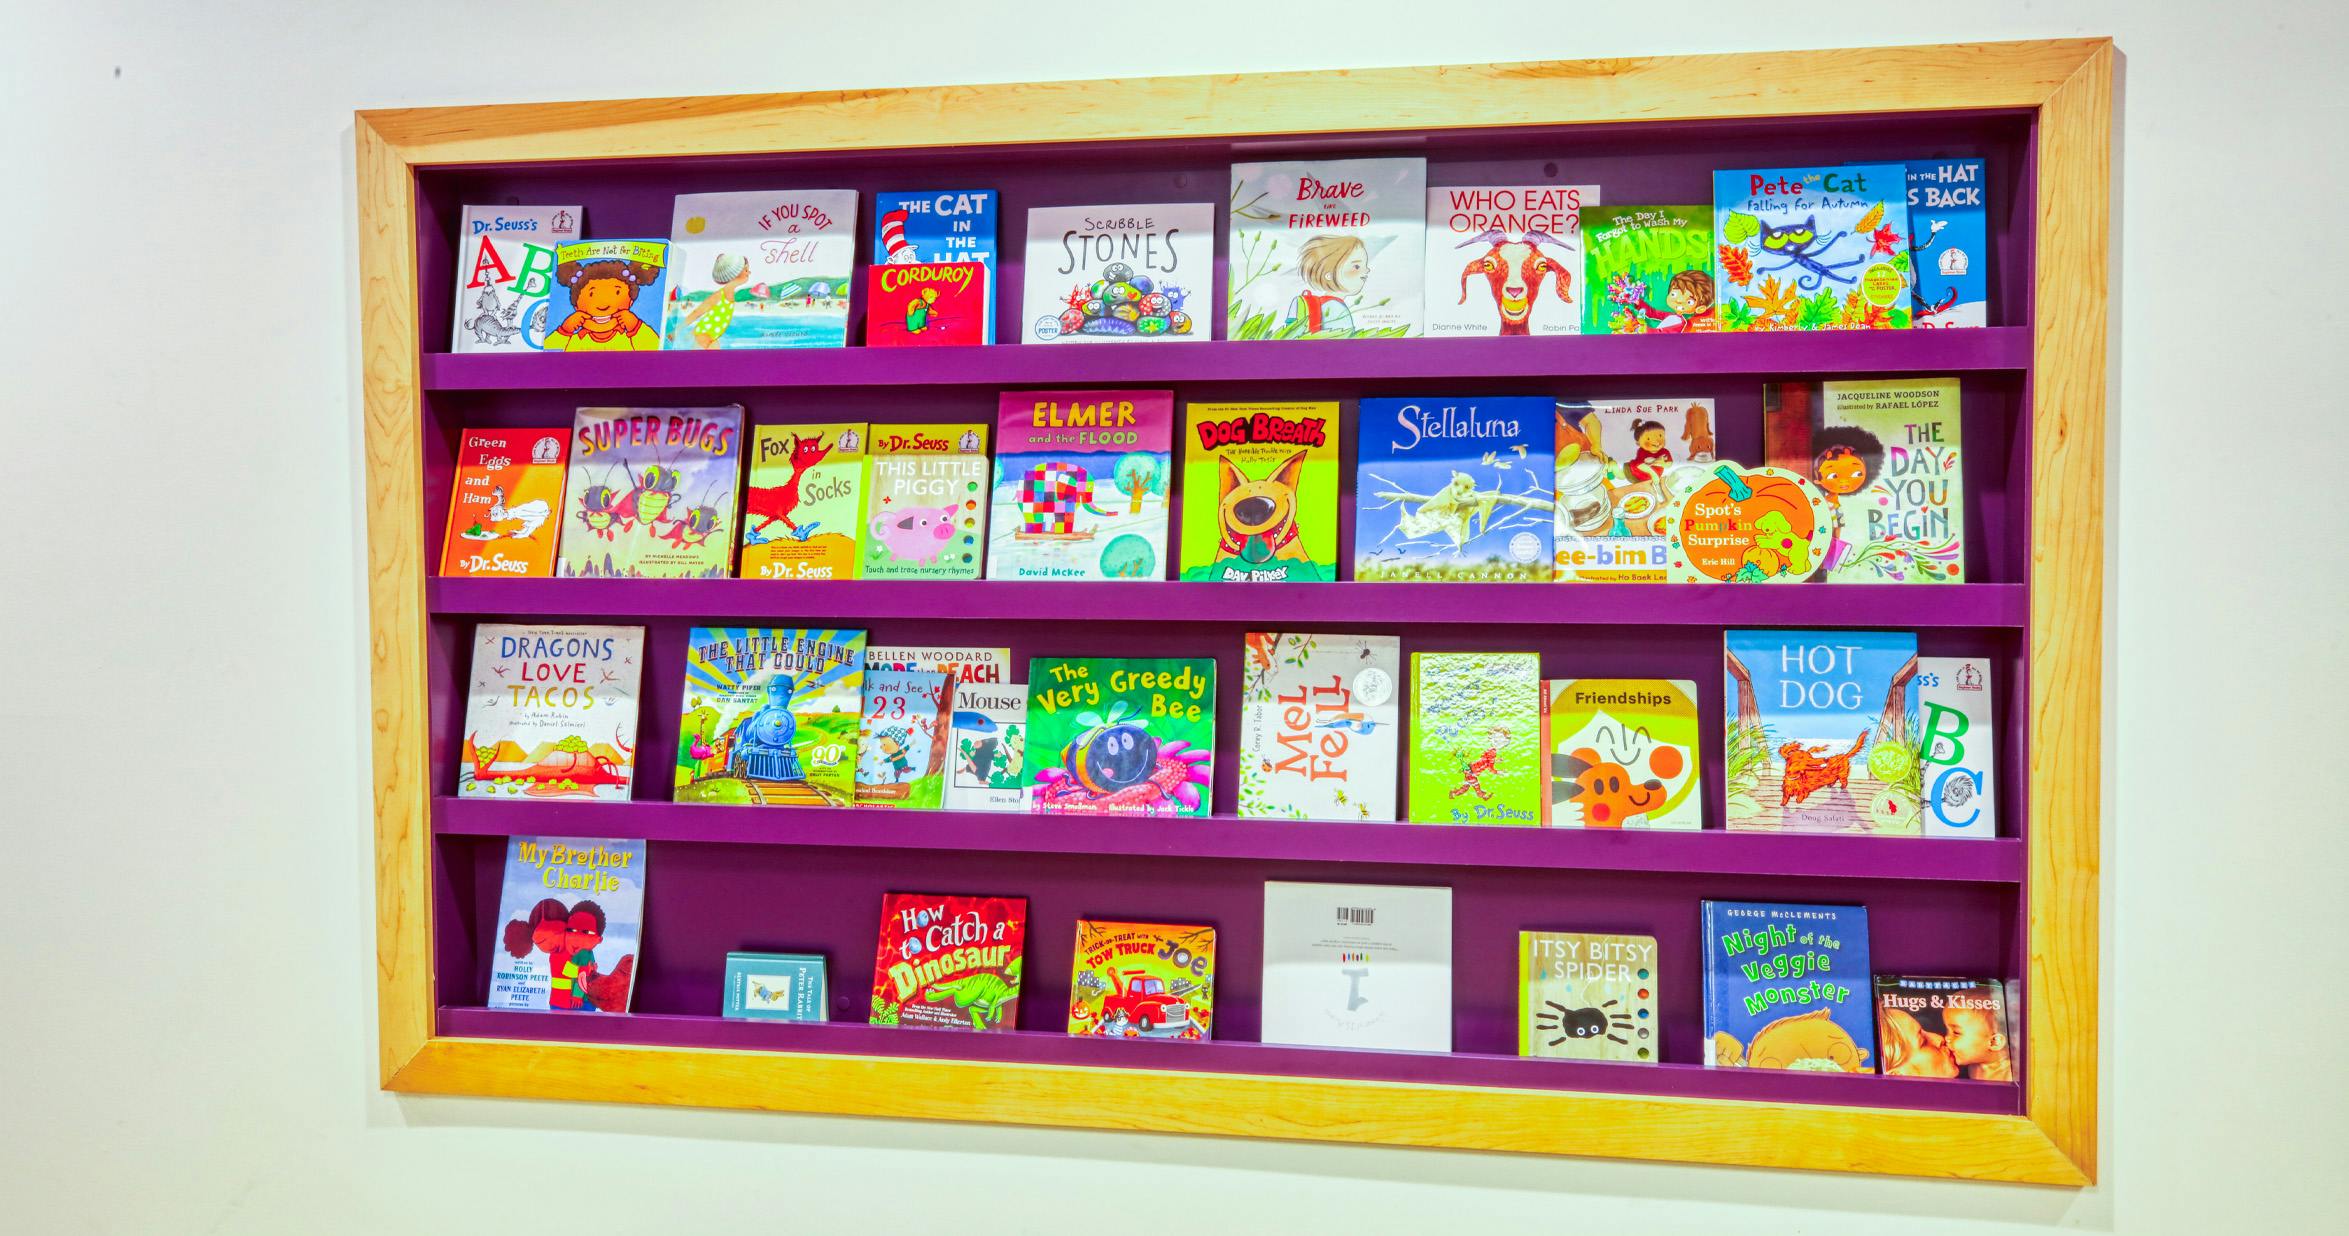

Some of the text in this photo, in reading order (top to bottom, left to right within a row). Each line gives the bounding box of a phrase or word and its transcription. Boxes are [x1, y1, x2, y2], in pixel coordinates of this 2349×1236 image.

[1920, 173, 1936, 181] THE
[1938, 164, 1978, 183] HAT
[1297, 177, 1364, 200] Brave
[1750, 173, 1868, 196] Pete the Cat
[899, 194, 988, 216] THE CAT
[1450, 190, 1580, 211] WHO EATS
[1748, 197, 1868, 214] Falling for Autumn
[1925, 187, 1981, 208] BACK
[472, 217, 538, 234] Dr. Seuss's
[758, 204, 832, 231] IF YOU SPOT
[954, 221, 971, 232] IN
[1085, 218, 1154, 231] SCRIBBLE
[1450, 214, 1579, 234] ORANGE?
[1613, 216, 1633, 226] The
[1636, 212, 1657, 220] Day
[788, 224, 800, 234] a
[1596, 226, 1628, 242] Forgot
[1631, 223, 1641, 231] to
[1674, 218, 1688, 227] My
[946, 237, 976, 248] THE
[1058, 229, 1180, 275] STONES
[1590, 228, 1709, 273] HANDS
[561, 245, 659, 262] Teeth Are Not for Biting
[881, 266, 974, 297] CORDUROY
[1432, 323, 1462, 331] Dianne
[1837, 391, 1940, 401] JACQUELINE WOODSON
[1032, 401, 1136, 428] ELMER
[1605, 405, 1632, 414] LINDA
[1657, 405, 1679, 413] PARK
[579, 415, 734, 457] SUPER BUGS
[1029, 432, 1138, 445] and the FLOOD
[1197, 417, 1248, 450] DOG
[1392, 405, 1522, 454] Stellaluna
[1904, 422, 1945, 445] THE
[469, 437, 507, 448] Green
[761, 437, 790, 462] Fox
[879, 433, 949, 452] By Dr. Seuss
[480, 454, 511, 470] Eggs
[877, 461, 981, 476] THIS LITTLE
[1890, 446, 1945, 477] DAY
[465, 476, 491, 486] and
[812, 470, 821, 480] in
[803, 477, 852, 507] Socks
[894, 479, 959, 496] PIGGY
[1884, 479, 1949, 510] YOU
[463, 493, 491, 504] Ham
[1695, 503, 1742, 518] Spot's
[1685, 519, 1753, 533] Pumpkin
[1688, 535, 1750, 548] Surprise
[460, 553, 528, 573] By Dr. Seuss
[761, 561, 833, 579] By Dr. Seuss
[866, 566, 884, 574] Touch
[948, 567, 974, 575] rhymes
[1702, 558, 1718, 566] Eric
[1019, 568, 1085, 577] David McKee
[501, 637, 615, 661] DRAGONS
[698, 637, 855, 667] THE LITTLE ENGINE
[869, 651, 993, 662] BELLEN WOODARD
[726, 653, 825, 674] THAT COULD
[1782, 645, 1863, 675] HOT
[522, 662, 586, 683] LOVE
[1050, 663, 1089, 683] The
[1110, 666, 1206, 699] Greedy
[879, 681, 923, 693] and See
[1779, 680, 1863, 710] DOG
[507, 685, 595, 710] TACOS
[958, 692, 1021, 710] Mouse
[1036, 681, 1100, 715] Very
[1576, 693, 1671, 707] Friendships
[1151, 693, 1201, 723] Bee
[1157, 804, 1172, 812] Jack
[1175, 805, 1194, 813] Tickle
[1452, 804, 1534, 823] By Dr. Seuss
[1801, 814, 1821, 823] Doug
[519, 841, 633, 870] My Brother
[543, 867, 620, 895] Charlie
[901, 905, 945, 933] How
[1728, 910, 1766, 918] GEORGE
[900, 911, 1005, 960] to Catch a
[1722, 924, 1841, 957] Night of the
[1086, 943, 1156, 969] TOW TRUCK
[1533, 940, 1652, 962] ITSY BITSY
[888, 945, 1011, 1003] Dinosaur
[1554, 961, 1631, 983] SPIDER
[1741, 951, 1831, 983] Veggie
[1744, 981, 1849, 1016] Monster
[1883, 994, 2000, 1011] Hugs & Kisses
